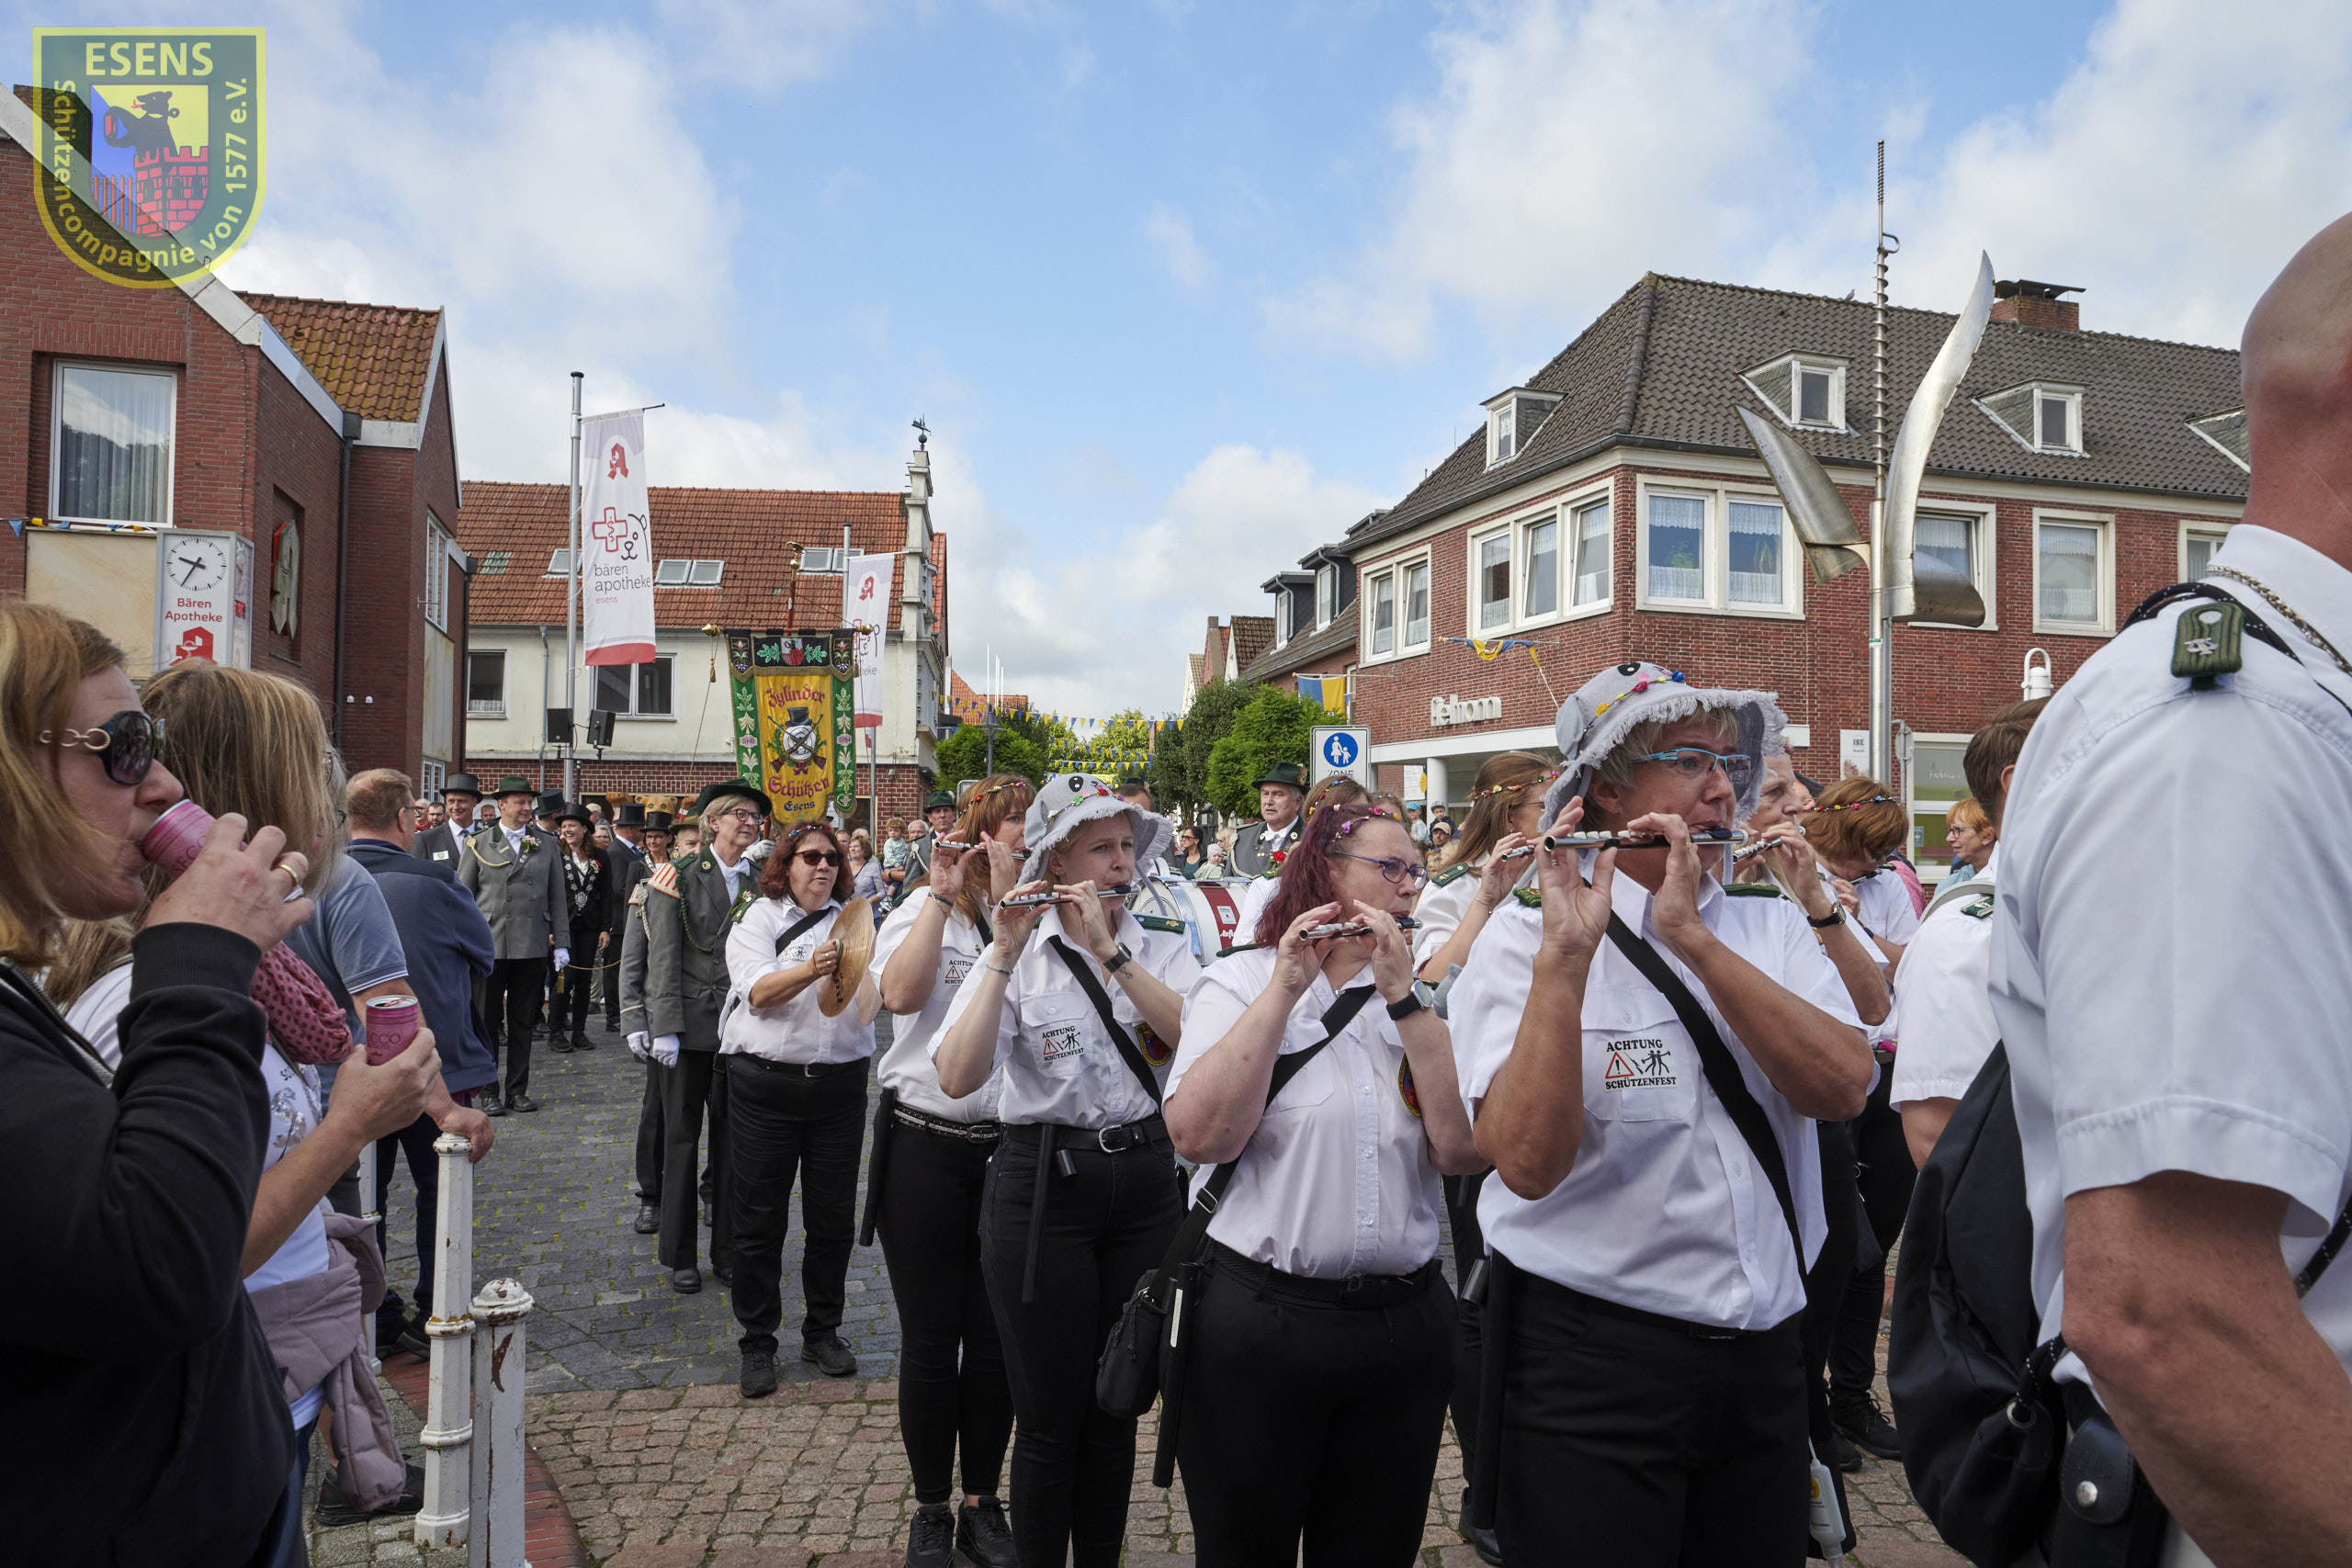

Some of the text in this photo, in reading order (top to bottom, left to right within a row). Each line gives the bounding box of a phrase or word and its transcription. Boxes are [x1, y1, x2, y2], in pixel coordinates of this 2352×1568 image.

[594, 563, 628, 578] bären
[594, 571, 651, 593] apotheke
[177, 598, 211, 608] Bären
[595, 596, 618, 604] esens
[165, 611, 222, 622] Apotheke
[768, 775, 830, 798] Schützen
[784, 800, 816, 811] Esens
[1042, 1026, 1076, 1039] ACHTUNG
[1606, 1039, 1663, 1053] ACHTUNG
[1044, 1047, 1084, 1062] SCHÜTZENFEST
[1605, 1077, 1677, 1090] SCHÜTZENFEST
